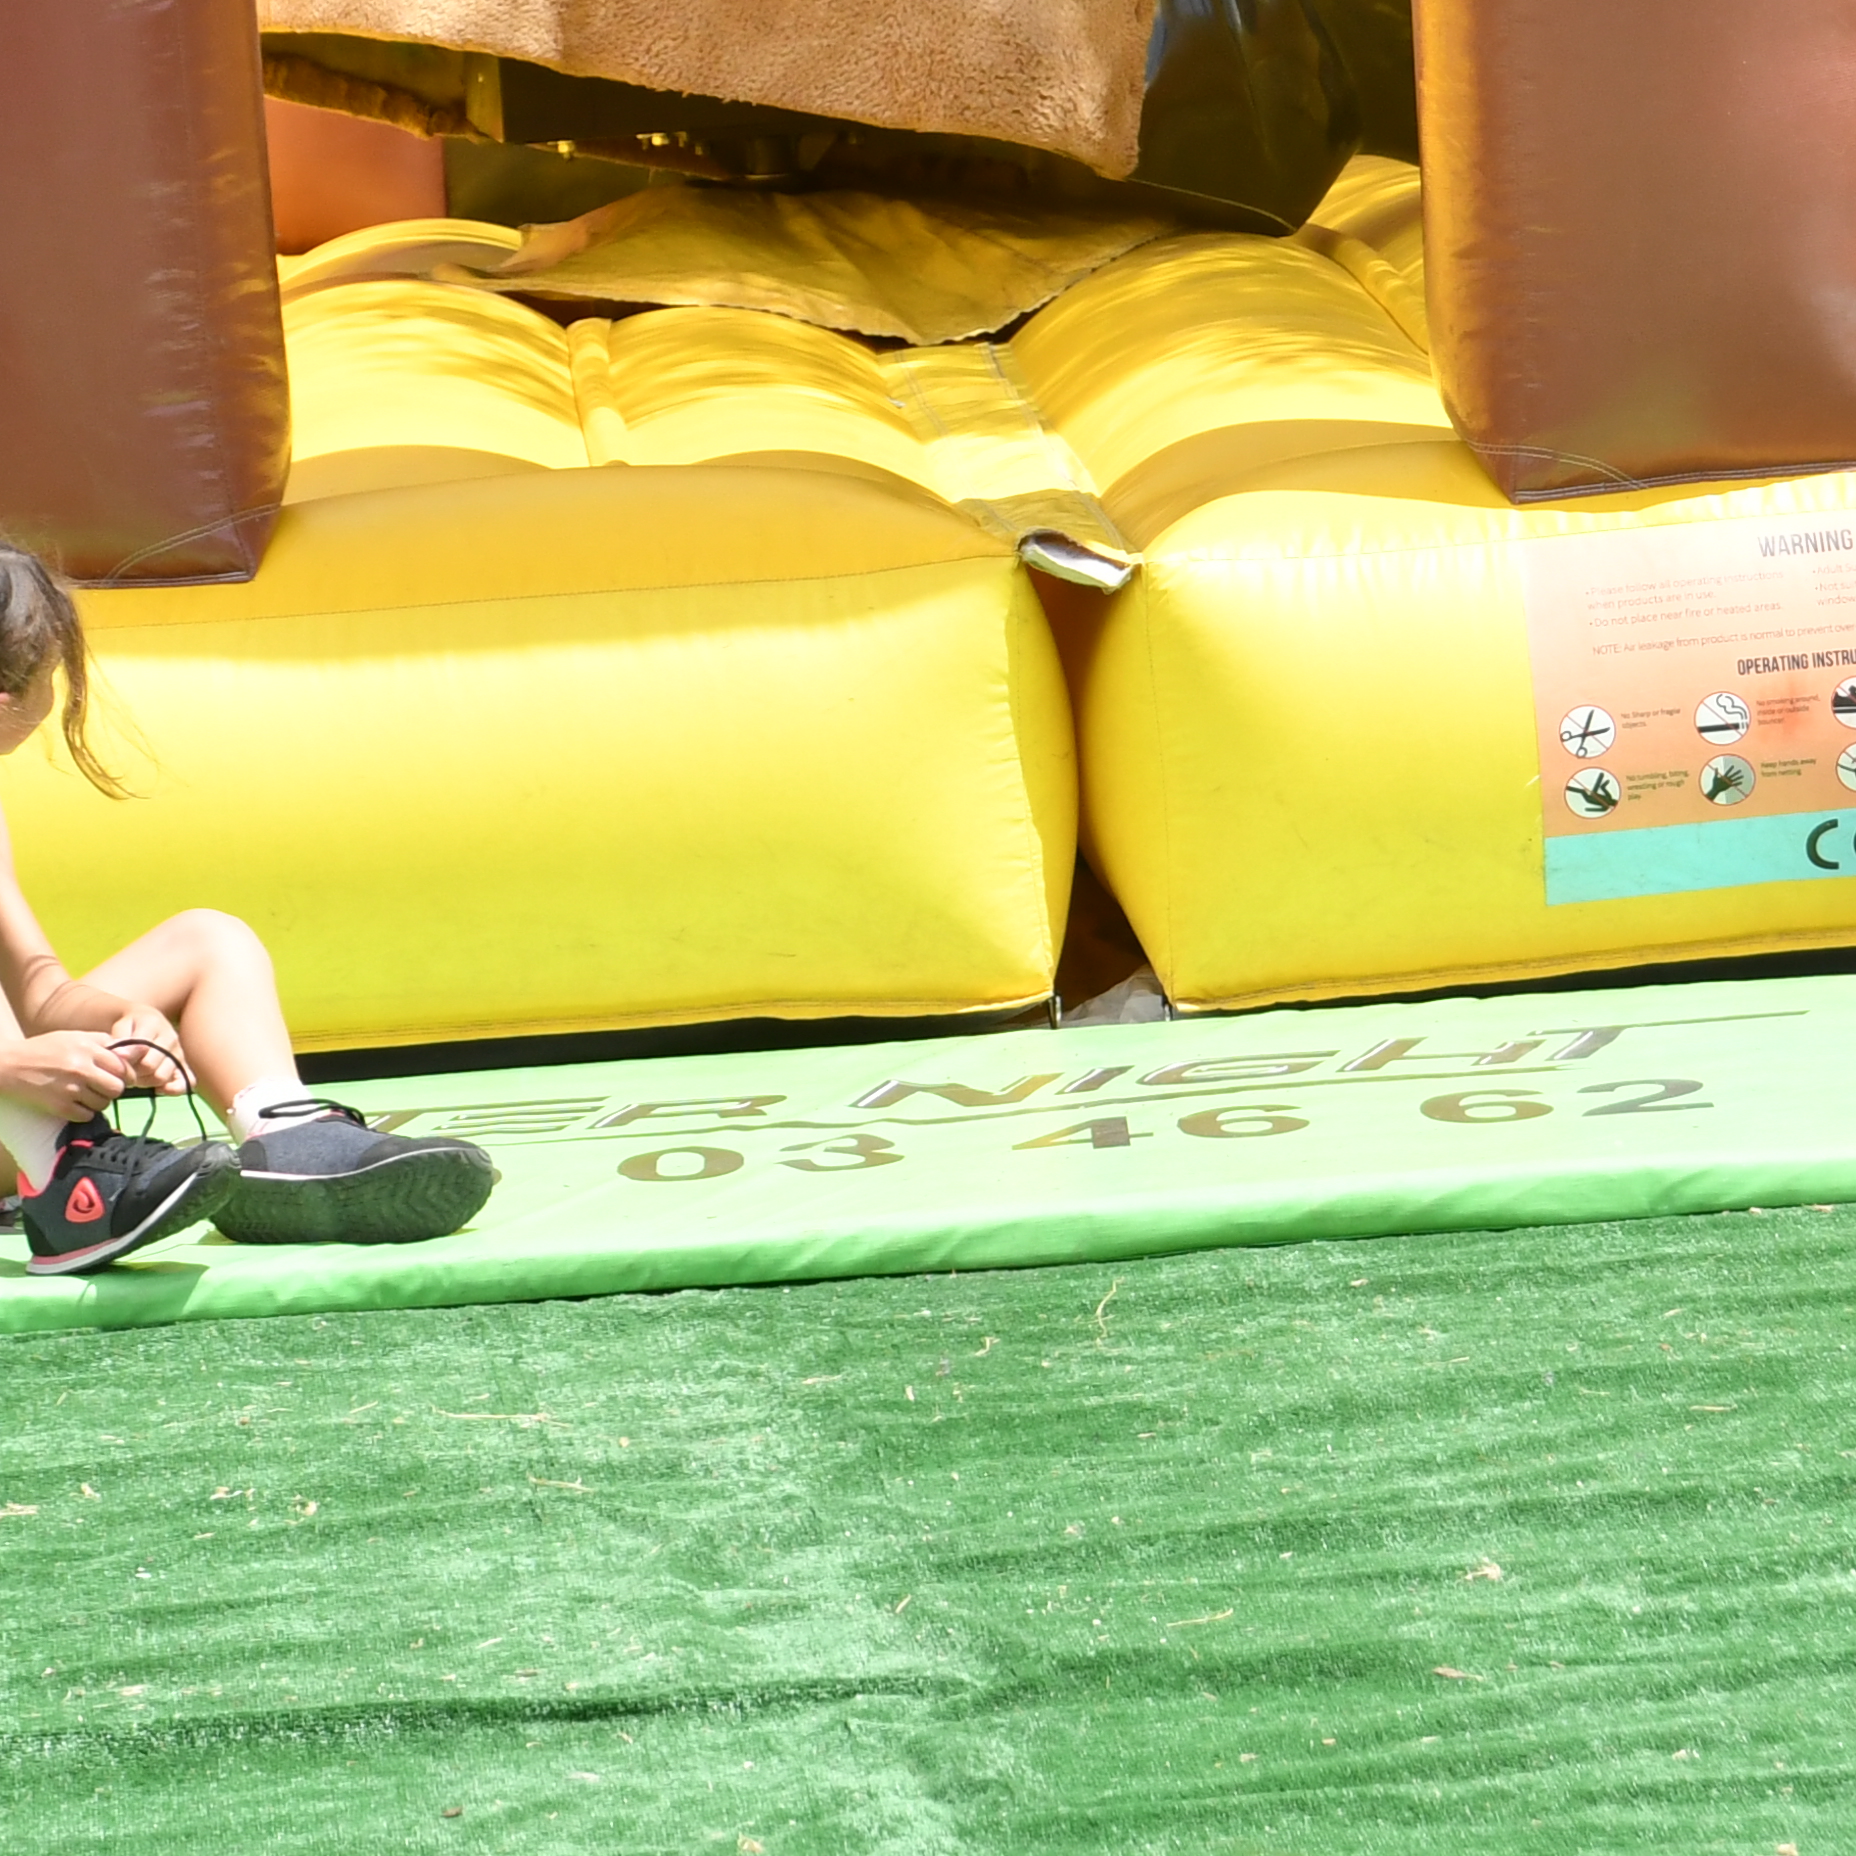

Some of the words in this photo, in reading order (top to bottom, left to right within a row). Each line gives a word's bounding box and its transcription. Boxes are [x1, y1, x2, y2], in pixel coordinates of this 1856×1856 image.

[1758, 528, 1854, 558] WARNING
[1817, 564, 1843, 574] Adult
[1591, 586, 1623, 595] Please
[1626, 583, 1656, 593] follow
[1659, 580, 1671, 589] all
[1673, 576, 1722, 588] operating
[1820, 582, 1838, 591] Not
[1587, 600, 1614, 610] when
[1618, 594, 1663, 609] products
[1666, 593, 1681, 602] are
[1685, 591, 1693, 599] in
[1816, 594, 1856, 606] window
[1595, 618, 1608, 627] Do
[1611, 615, 1628, 625] not
[1631, 612, 1658, 624] place
[1661, 610, 1683, 620] near
[1685, 608, 1701, 617] fire
[1704, 606, 1714, 616] or
[1717, 603, 1751, 614] heated
[1593, 643, 1621, 655] NOTE:
[1624, 643, 1635, 652] Air
[1638, 640, 1674, 651] leakage
[1676, 637, 1699, 647] from
[1701, 633, 1738, 645] product
[1741, 633, 1747, 641] is
[1750, 628, 1783, 639] normal
[1786, 628, 1795, 637] to
[1798, 624, 1834, 636] prevent
[1737, 652, 1809, 676] OPERATING
[848, 1010, 1809, 1110] NIGHT
[615, 1133, 905, 1182] 03
[1011, 1104, 1309, 1151] 46
[1420, 1079, 1714, 1123] 62
